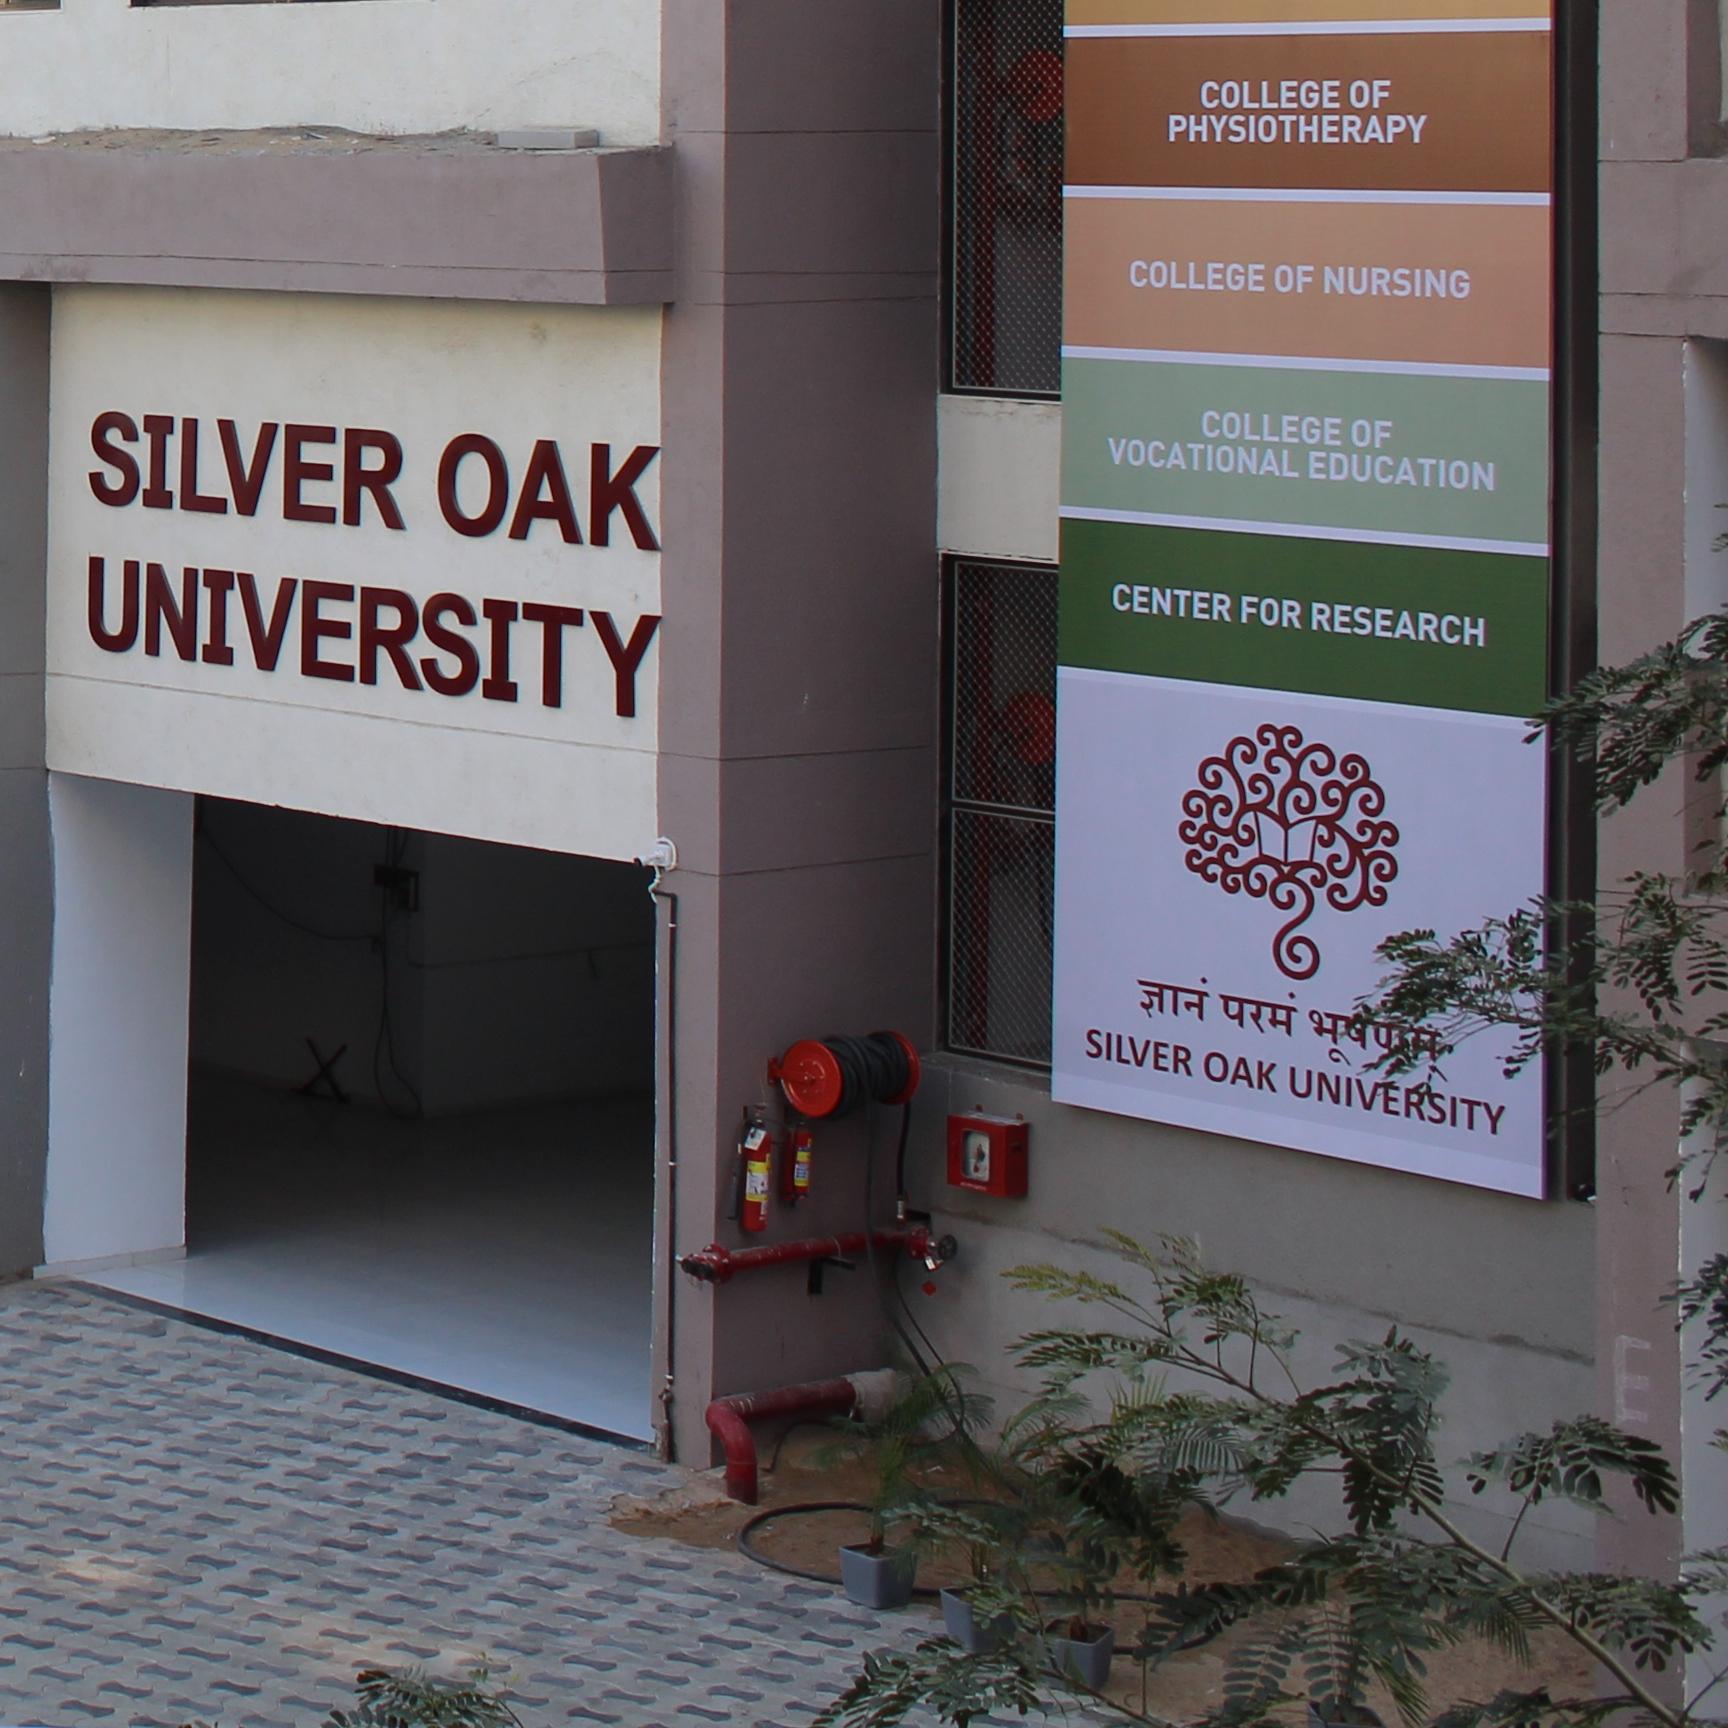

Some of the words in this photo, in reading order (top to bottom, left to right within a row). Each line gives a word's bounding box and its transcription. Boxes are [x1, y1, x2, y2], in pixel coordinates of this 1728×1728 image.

[1200, 80, 1342, 110] COLLEGE
[1348, 80, 1392, 110] OF
[1167, 114, 1428, 144] PHYSIOTHERAPY
[1128, 260, 1267, 292] COLLEGE
[1273, 264, 1315, 293] OF
[1322, 266, 1471, 300] NURSING
[1202, 410, 1343, 446] COLLEGE
[1350, 420, 1393, 449] OF
[88, 410, 407, 531] SILVER
[436, 432, 662, 552] OAK
[1108, 437, 1299, 478] VOCATIONAL
[1307, 451, 1495, 491] EDUCATION
[87, 555, 663, 718] UNIVERSITY
[1112, 583, 1233, 624] CENTER
[1240, 595, 1302, 630] FOR
[1310, 603, 1486, 647] RESEARCH
[1137, 976, 1211, 1022] ज्ञानं
[1219, 992, 1298, 1038] परमं
[1085, 1028, 1193, 1078] SILVER
[1203, 1051, 1277, 1093] OAK
[1288, 1066, 1506, 1136] UNIVERSITY
